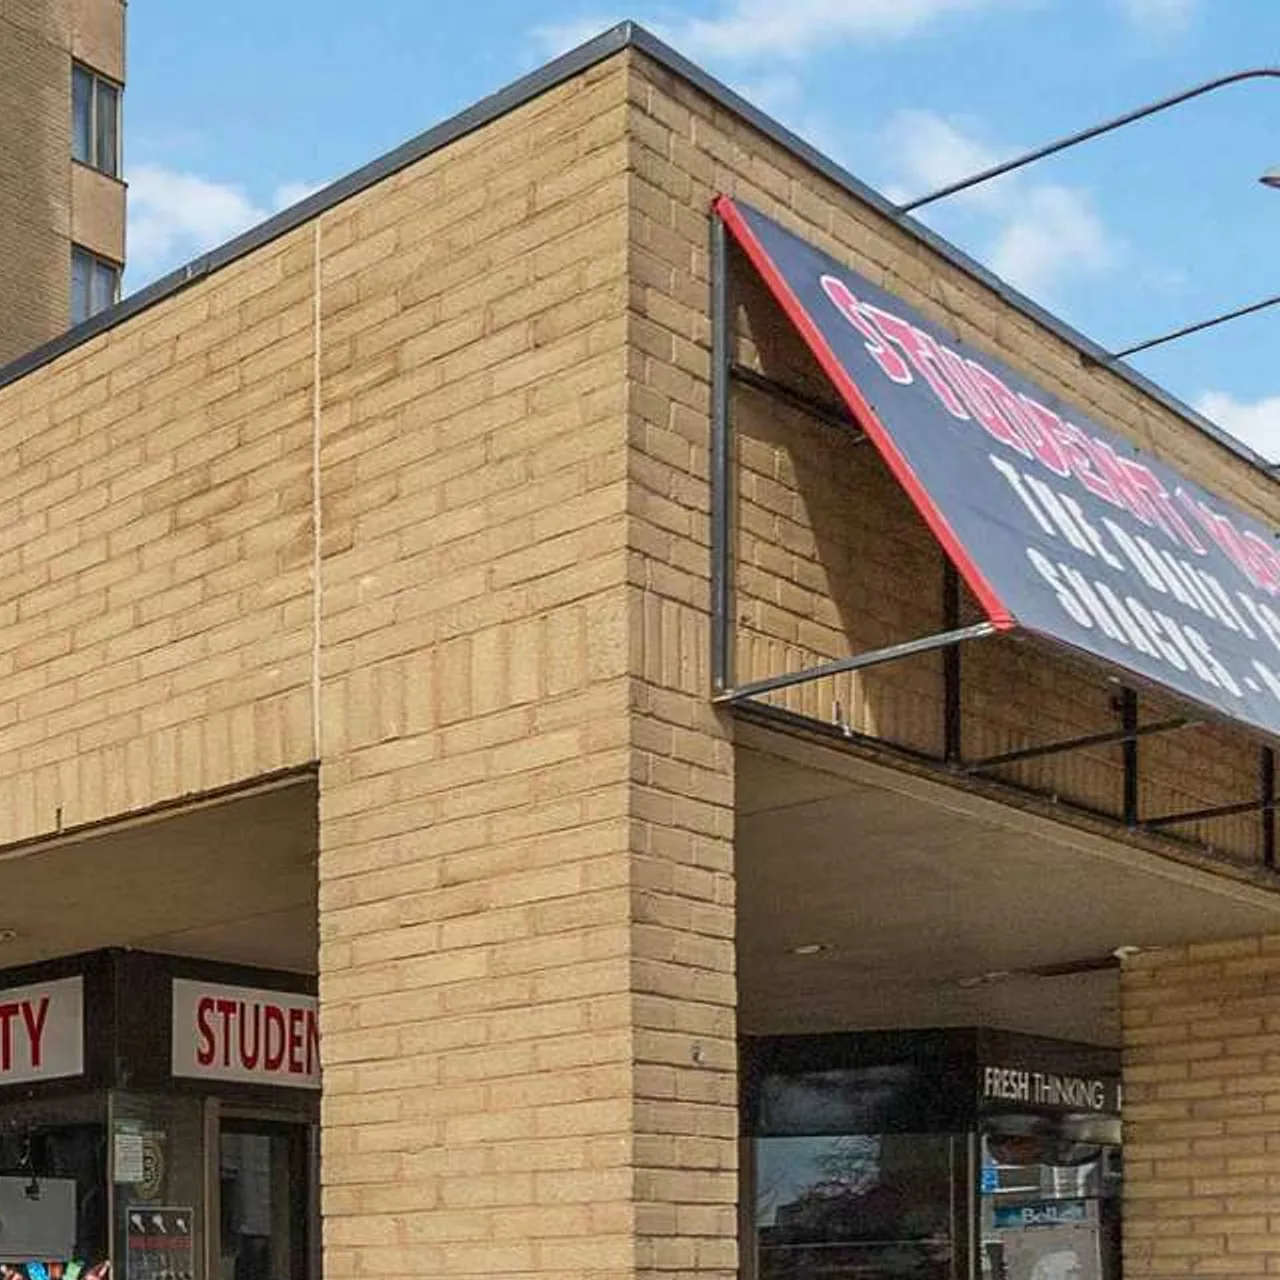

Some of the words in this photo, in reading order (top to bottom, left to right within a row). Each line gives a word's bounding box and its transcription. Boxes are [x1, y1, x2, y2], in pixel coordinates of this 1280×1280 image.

[821, 274, 1208, 556] STUDENT
[989, 454, 1125, 572] THE
[1101, 516, 1258, 641] DAILY
[1027, 547, 1243, 698] SNACKS
[984, 1067, 1030, 1101] FRESH
[1032, 1073, 1105, 1110] THINKING
